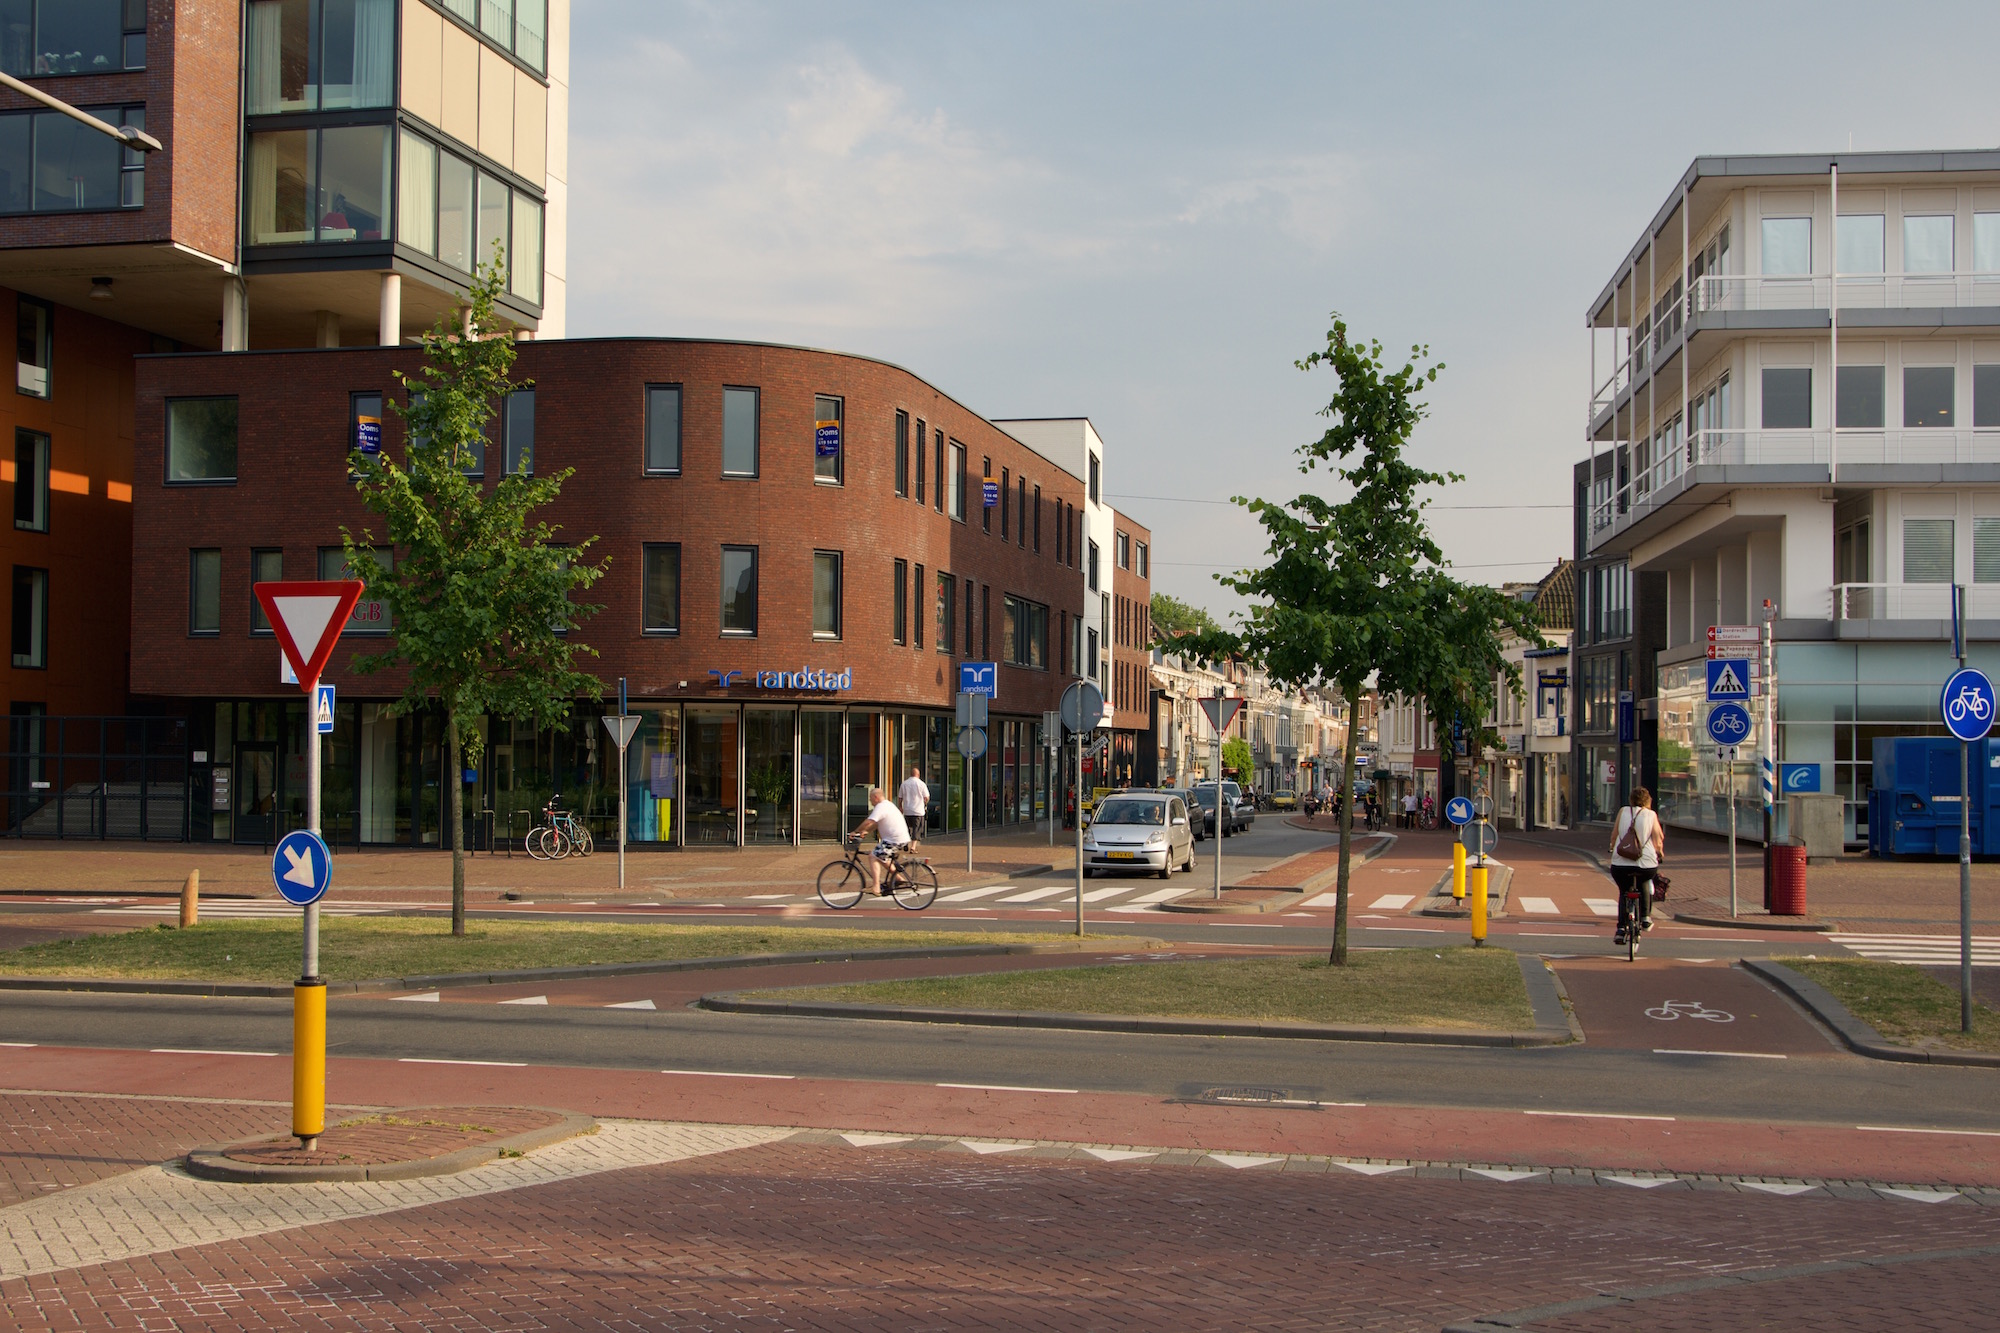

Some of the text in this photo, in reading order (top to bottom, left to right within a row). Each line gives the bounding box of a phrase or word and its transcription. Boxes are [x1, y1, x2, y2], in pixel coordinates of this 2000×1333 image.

[360, 423, 379, 433] Ooms
[351, 602, 381, 621] GB
[756, 665, 852, 690] randstad
[1540, 677, 1565, 685] Wrangler
